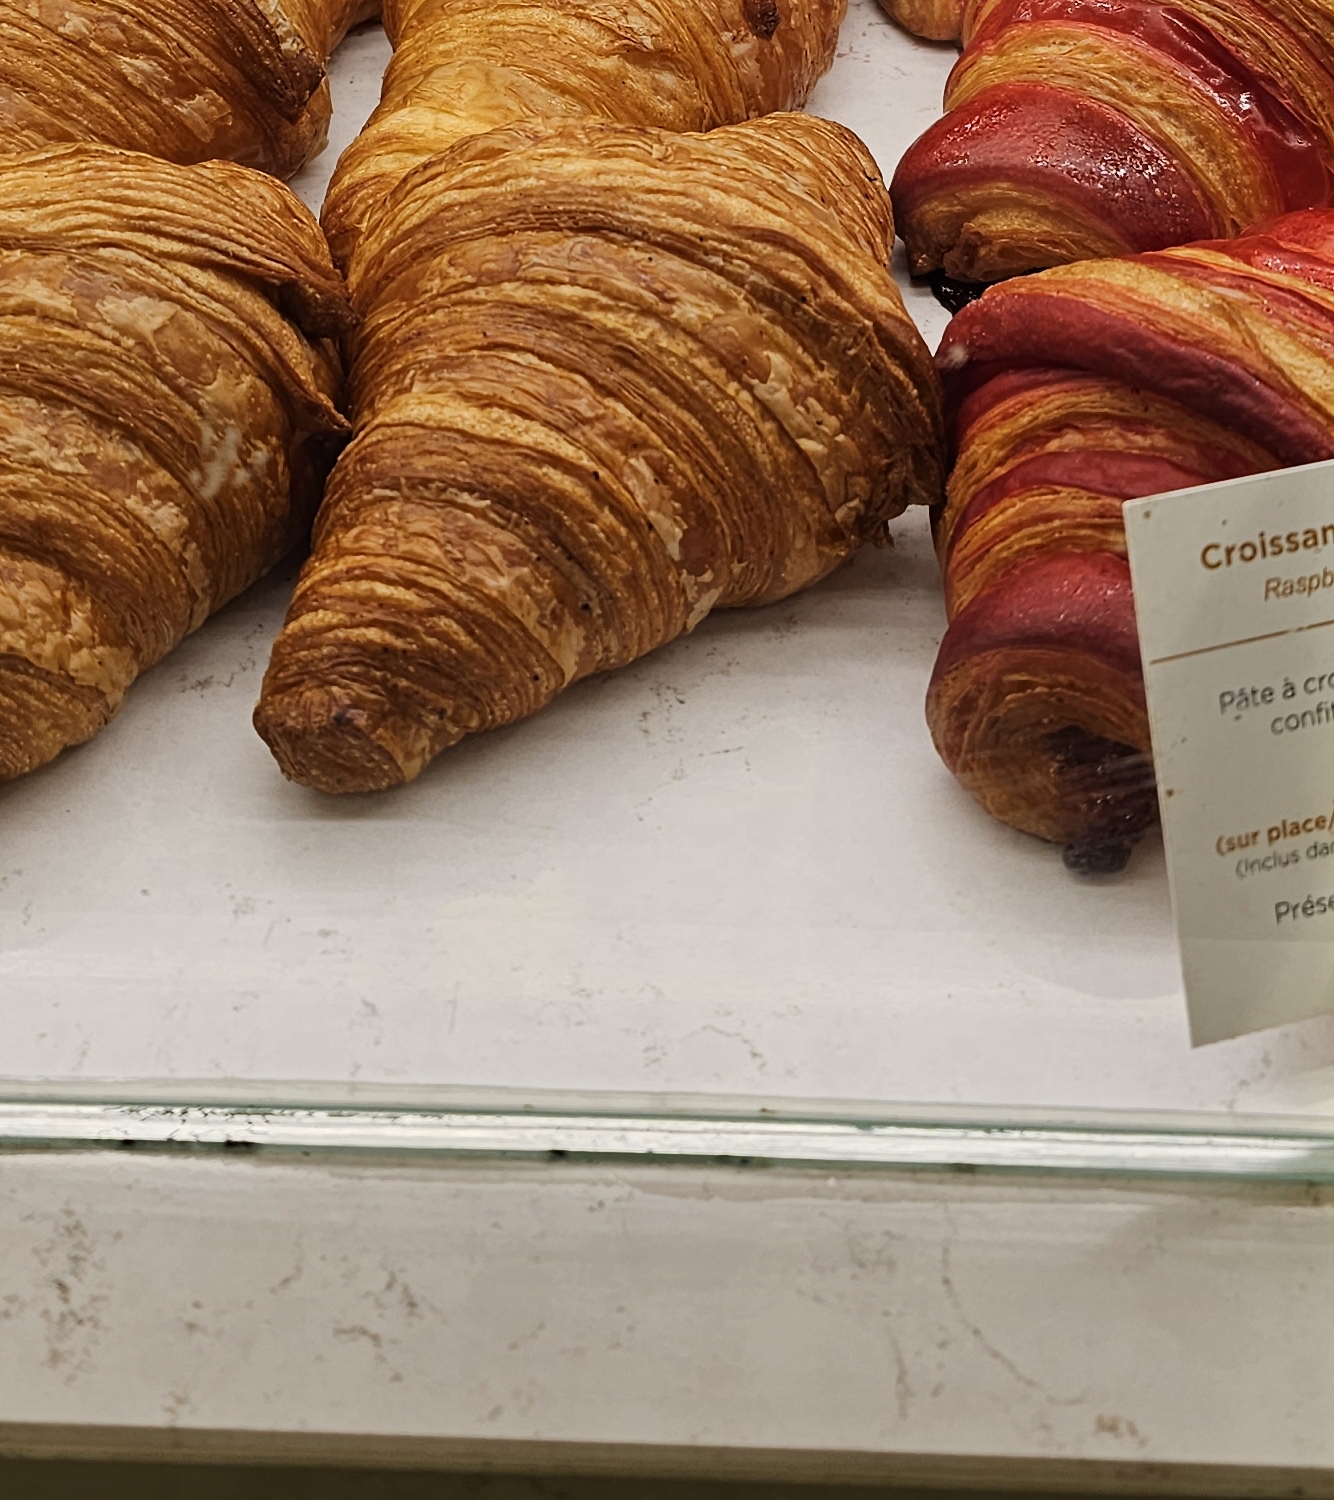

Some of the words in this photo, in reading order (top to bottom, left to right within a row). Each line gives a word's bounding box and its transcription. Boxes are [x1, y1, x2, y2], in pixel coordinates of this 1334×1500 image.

[1218, 682, 1275, 716] Pâte
[1280, 676, 1298, 701] à
[1216, 829, 1261, 858] (sur
